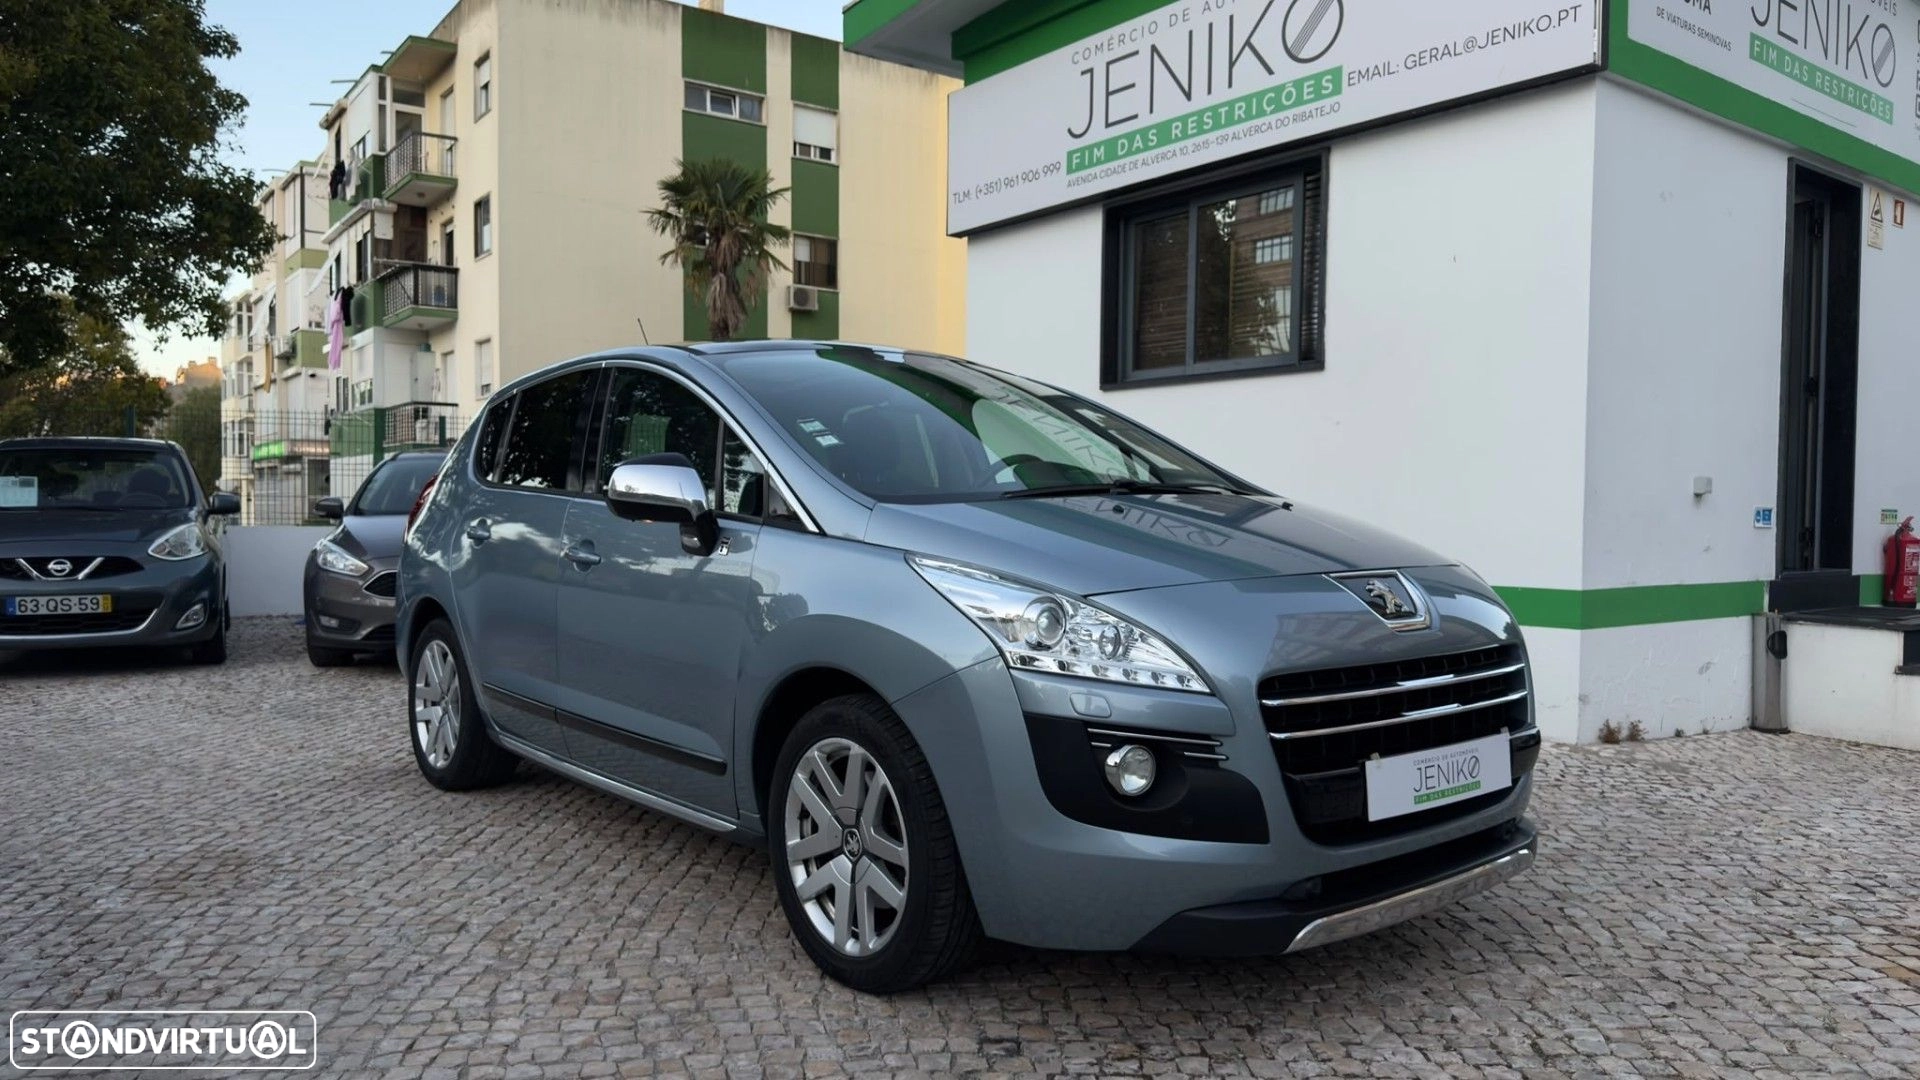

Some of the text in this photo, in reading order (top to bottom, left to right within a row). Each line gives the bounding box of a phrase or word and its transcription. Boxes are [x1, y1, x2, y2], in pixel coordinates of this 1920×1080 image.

[1072, 20, 1158, 65] COMÉRCIO
[1169, 8, 1191, 27] DE
[1347, 5, 1582, 87] EMAIL: GERAL@JENIKO.PT
[1656, 6, 1732, 51] DE VIATURAS SEMINOVAS
[1754, 40, 1891, 119] FIM DAS RESTRIÇÕES
[1067, 171, 1098, 188] AVENIDA
[1100, 166, 1127, 180] CIDADE
[1129, 162, 1139, 172] DE
[1141, 150, 1177, 168] ALVERCA
[1191, 133, 1229, 153] 2615-139
[1231, 122, 1273, 142] ALVERCA
[1275, 116, 1290, 129] DO
[1292, 102, 1341, 124] RIBATEJO
[1072, 75, 1333, 169] FIM DAS RESTRIÇÕES
[975, 178, 1002, 199] (+351)
[1003, 174, 1019, 189] 961
[1021, 168, 1040, 183] 906
[1043, 161, 1061, 177] 999
